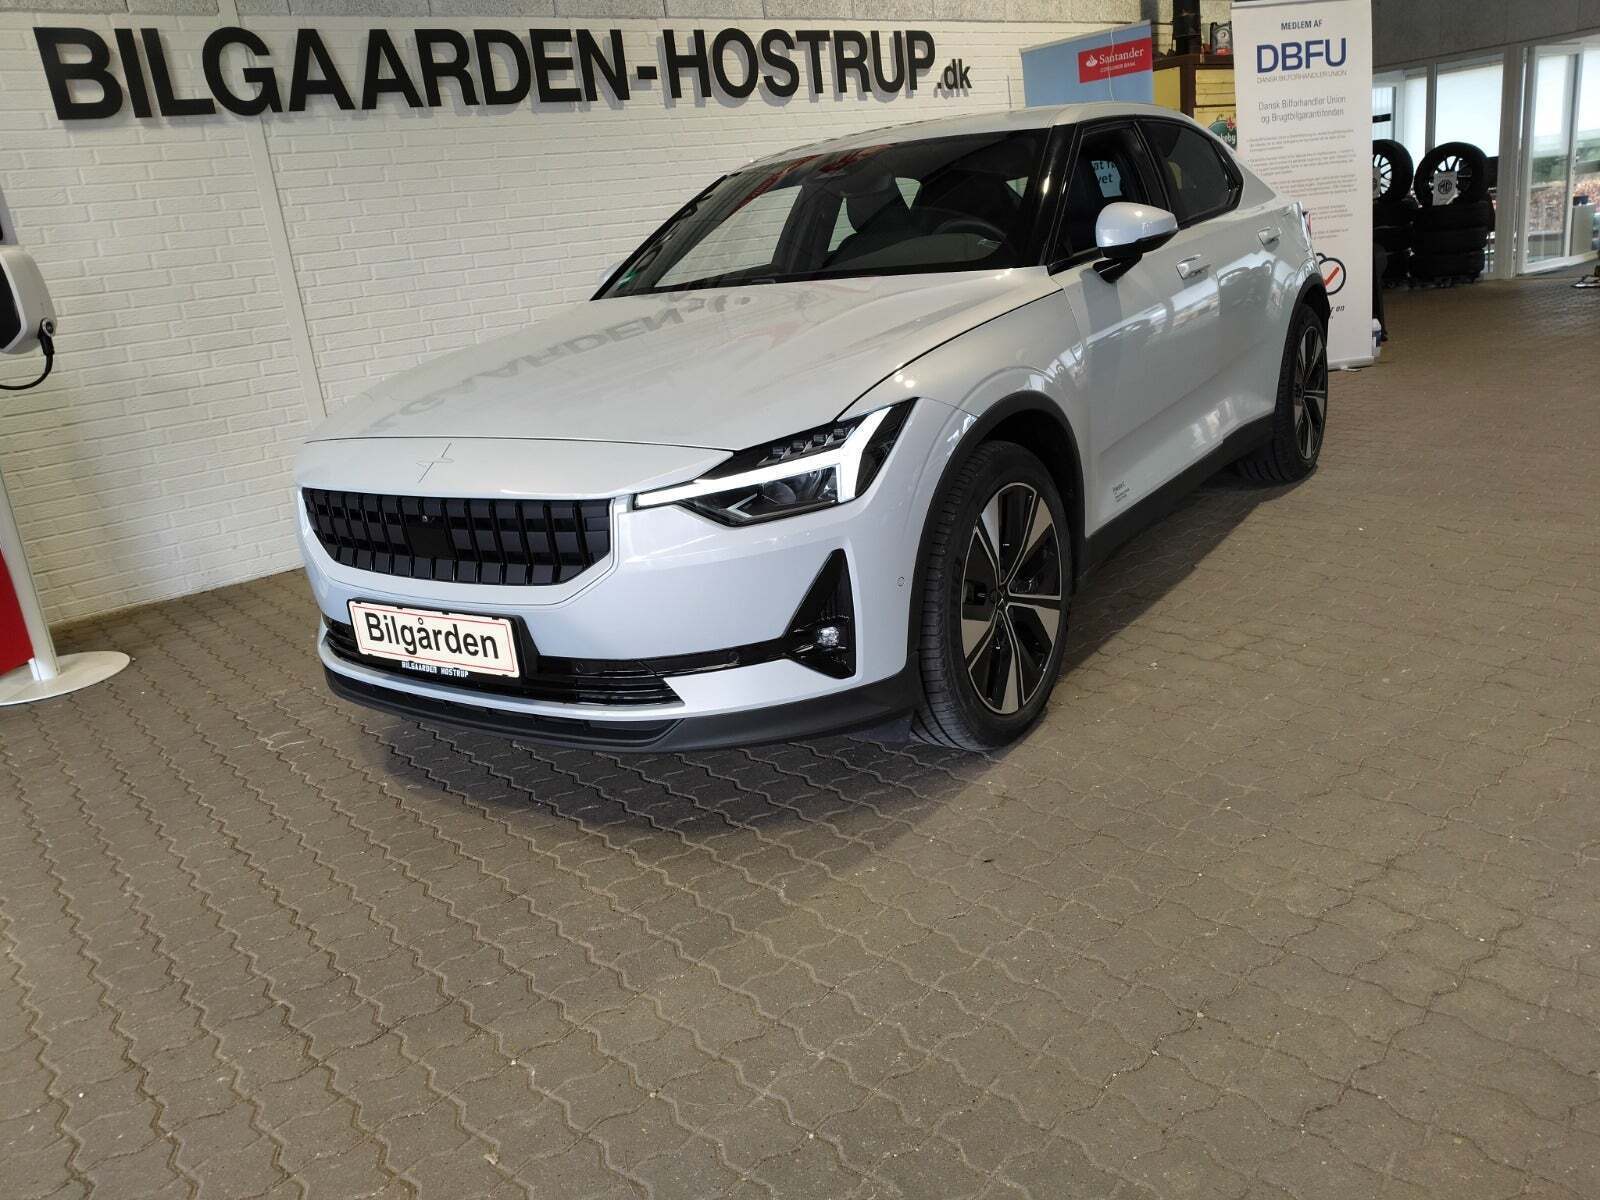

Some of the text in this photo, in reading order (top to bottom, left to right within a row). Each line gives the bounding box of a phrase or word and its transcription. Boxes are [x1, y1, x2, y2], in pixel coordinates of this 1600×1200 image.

[1281, 19, 1323, 30] MEDLEM AF
[1100, 47, 1144, 64] Santander
[1257, 38, 1346, 74] DBFU
[1258, 101, 1280, 111] Dansk
[1327, 96, 1346, 105] Union
[1261, 115, 1270, 124] og
[365, 612, 499, 659] Bilgården
[401, 661, 469, 678] BILGAARDEN HOSTRUP
